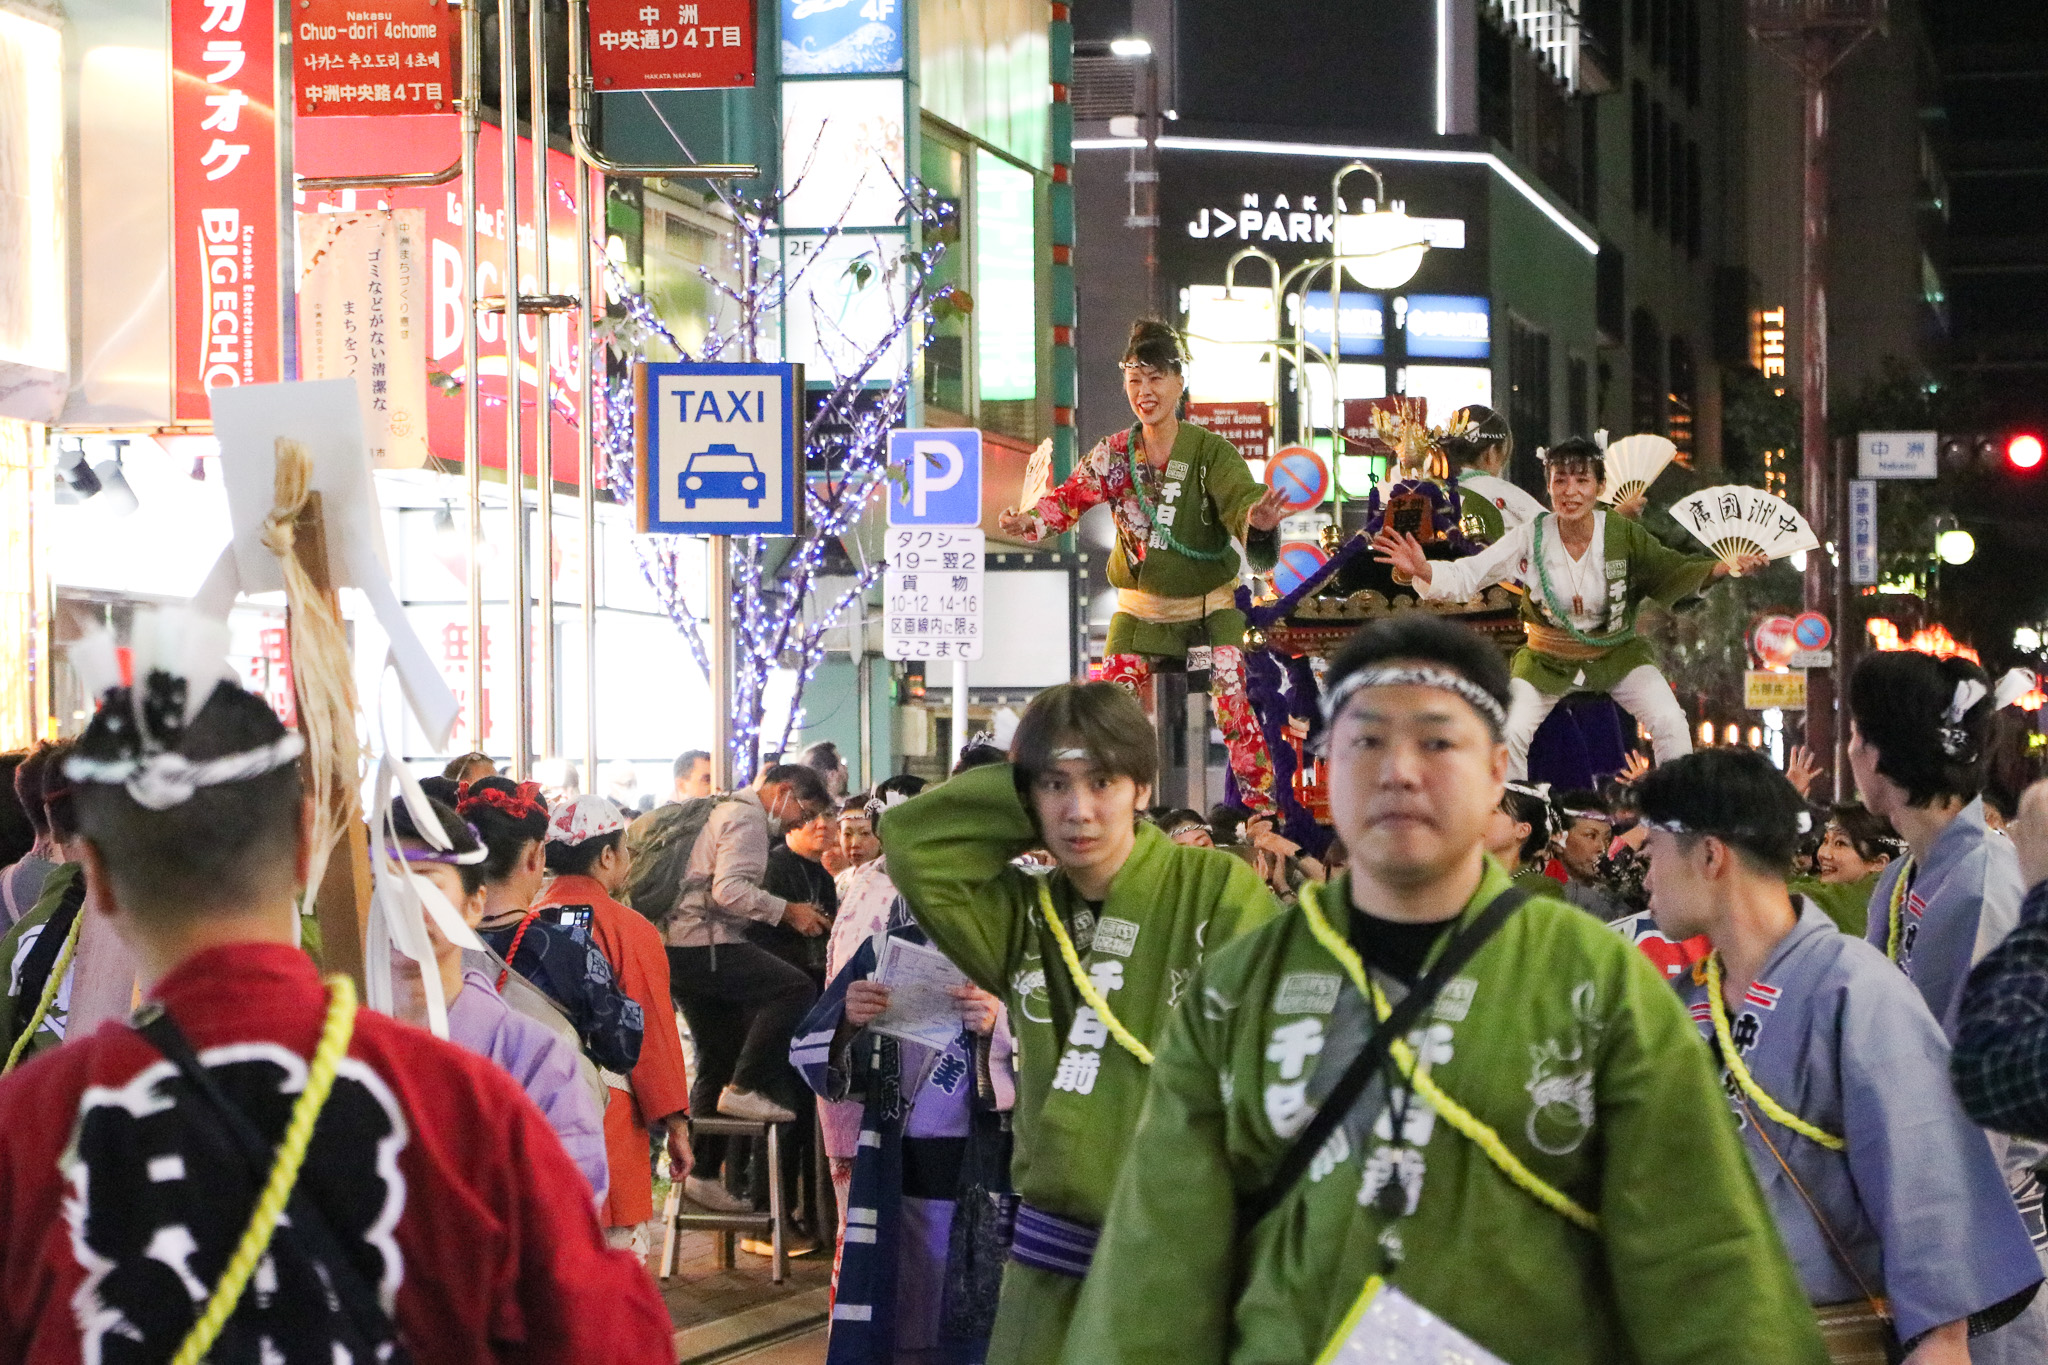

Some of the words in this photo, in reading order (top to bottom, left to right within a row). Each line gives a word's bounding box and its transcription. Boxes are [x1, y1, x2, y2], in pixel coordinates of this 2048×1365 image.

[347, 11, 392, 21] Nakasu
[859, 0, 896, 21] 4F
[301, 22, 378, 40] Chuo-dori
[384, 21, 437, 39] 4chome
[599, 26, 742, 51] 中央通り4丁目
[304, 53, 345, 71] 나카스
[348, 52, 400, 70] 추오도리
[200, 0, 250, 181] カラオケ
[305, 83, 443, 102] 中洲中央路4丁目
[201, 208, 240, 284] BIG
[243, 225, 254, 280] Karaoke
[790, 241, 813, 256] 2F
[243, 284, 255, 383] Entertainment
[1763, 306, 1785, 379] THE
[671, 390, 765, 423] TAXI
[913, 440, 964, 516] P
[897, 531, 972, 548] タクシー
[891, 595, 929, 612] 10-12
[940, 595, 977, 612] 14-16
[891, 617, 978, 635] 区画線内に限る
[896, 640, 972, 657] ここまで
